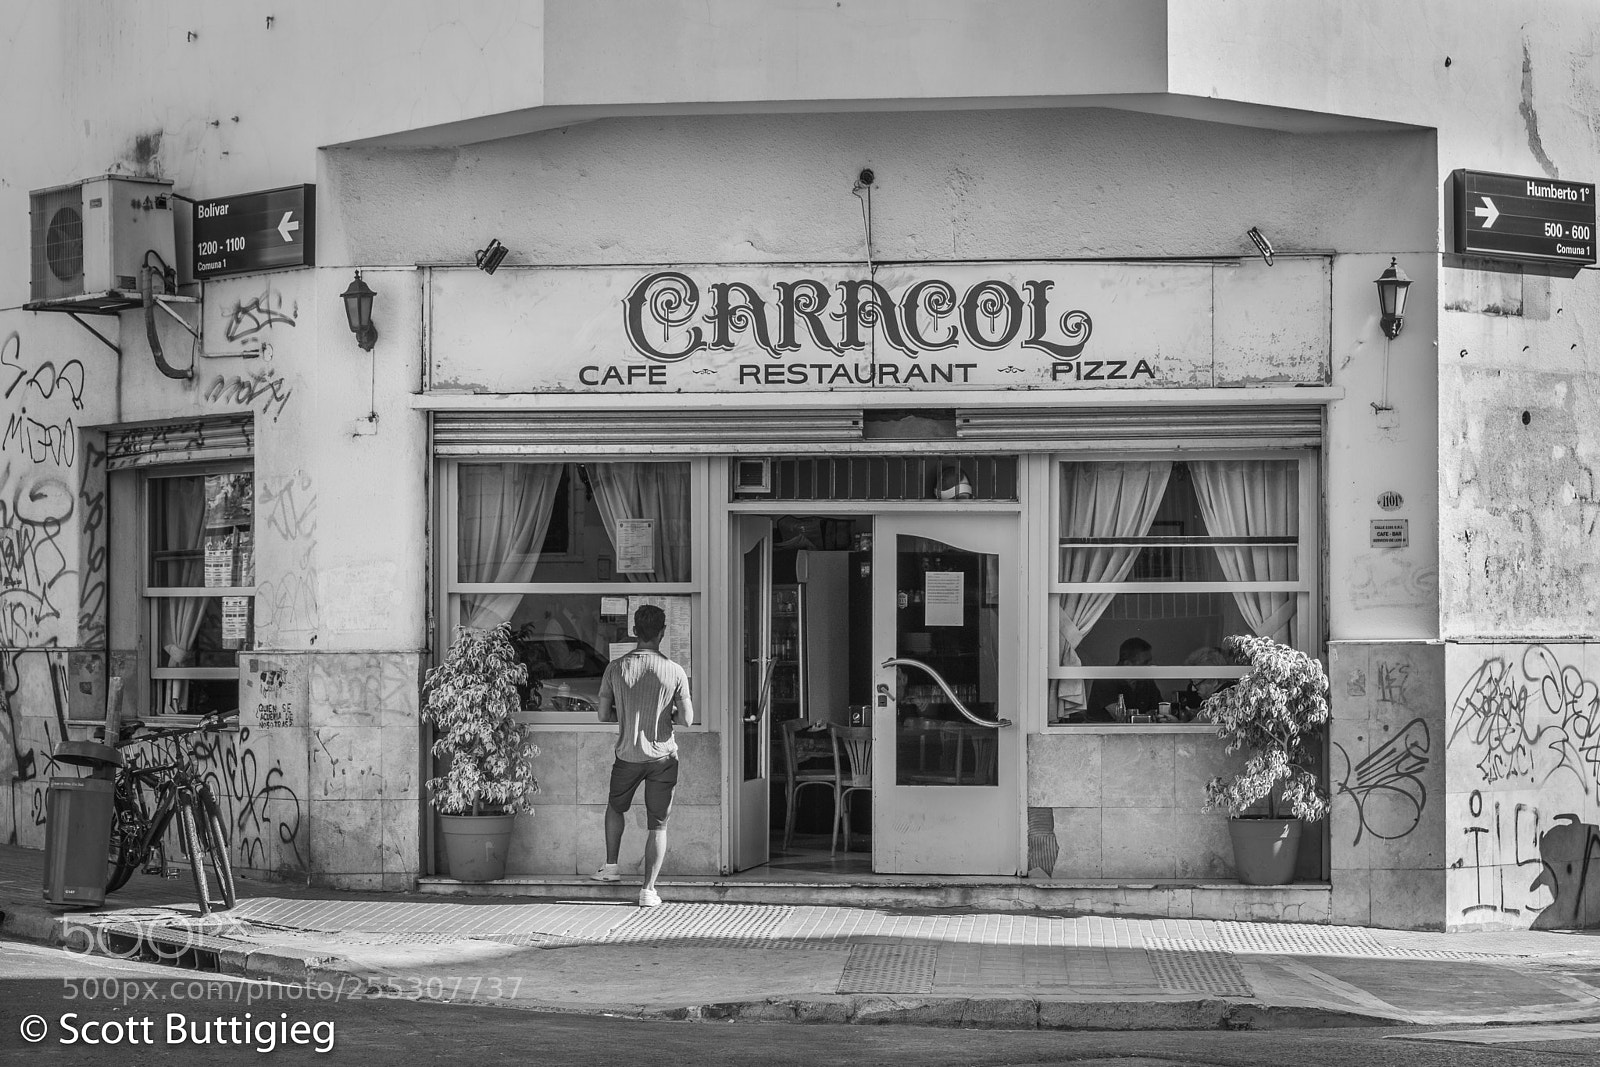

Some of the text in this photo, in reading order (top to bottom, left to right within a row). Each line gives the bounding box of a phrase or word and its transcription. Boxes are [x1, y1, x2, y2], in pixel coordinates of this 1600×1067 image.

[1526, 181, 1577, 201] Humberto
[198, 203, 230, 219] Bolívar
[1544, 222, 1563, 238] 500
[1571, 225, 1590, 241] 600
[198, 240, 218, 256] 1200
[225, 236, 246, 252] 1100
[1556, 243, 1590, 256] Comuna 1
[197, 258, 227, 271] Comuna 1
[621, 271, 1093, 362] CARACOL
[579, 359, 1156, 385] CAFE RESTAURANT PIZZA
[1383, 495, 1398, 507] 1101
[281, 703, 292, 713] SE
